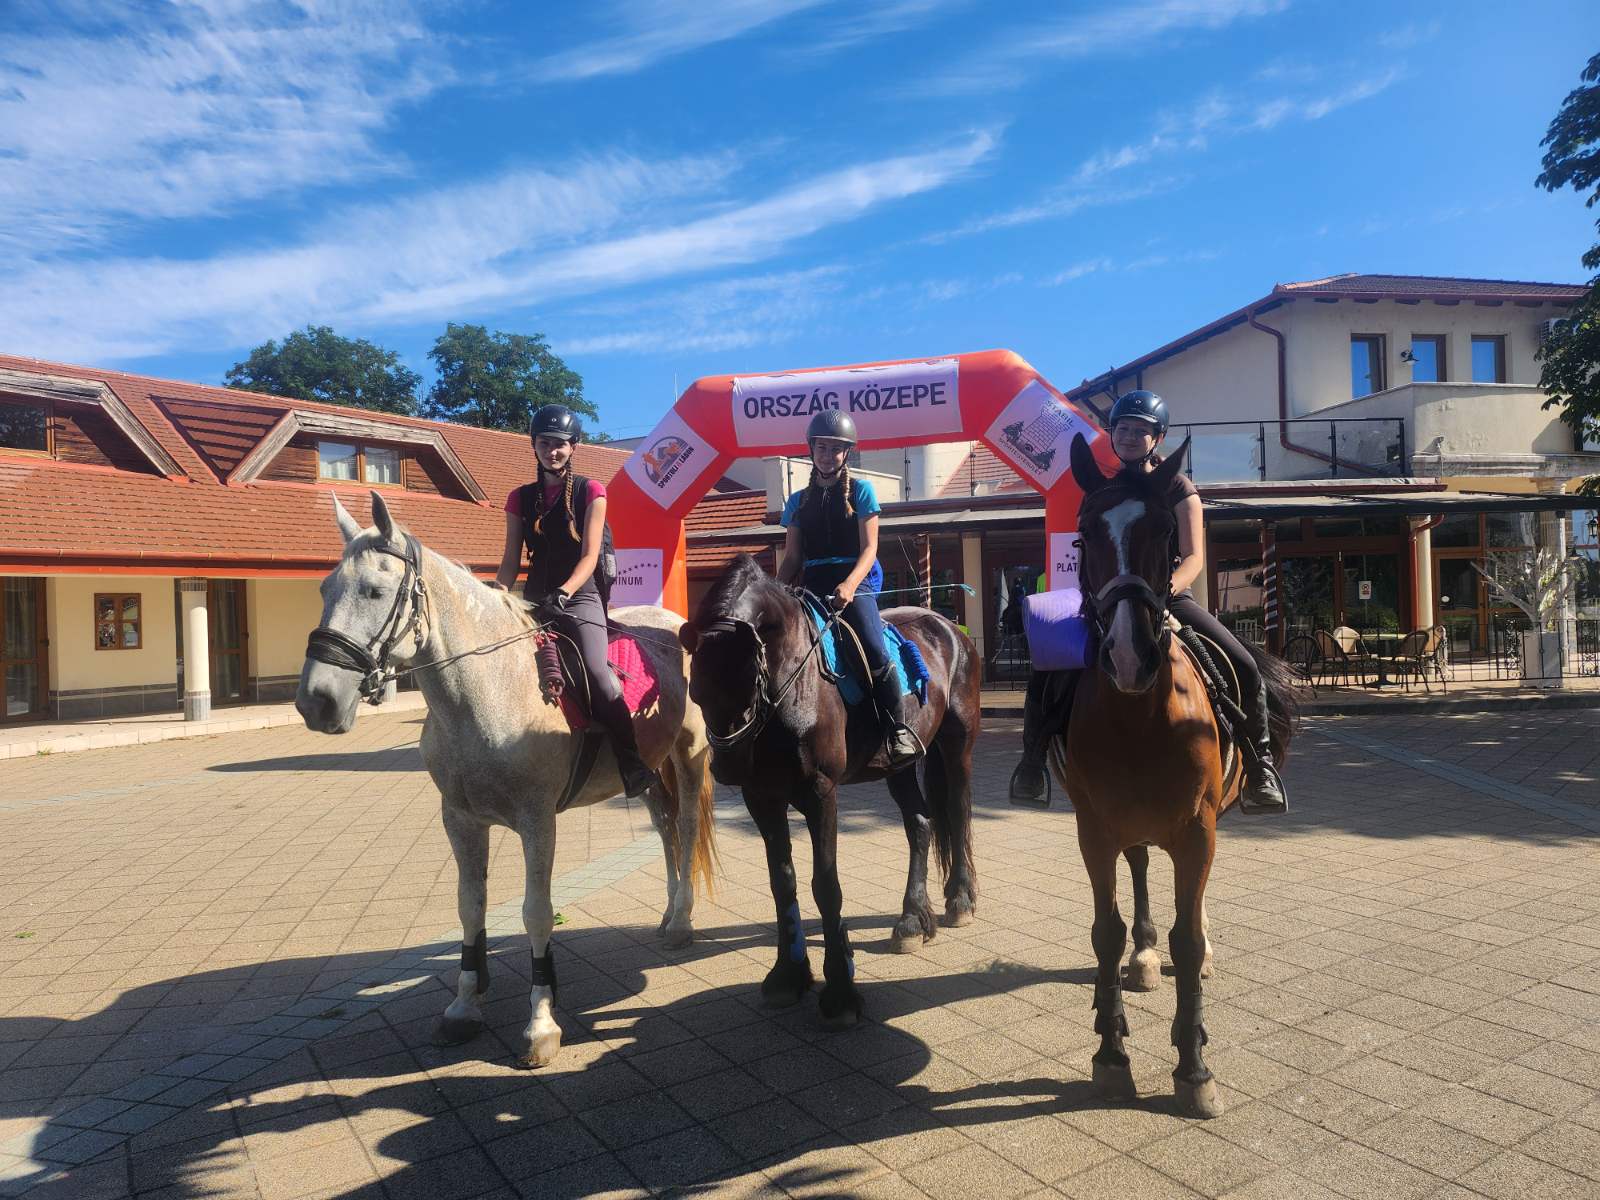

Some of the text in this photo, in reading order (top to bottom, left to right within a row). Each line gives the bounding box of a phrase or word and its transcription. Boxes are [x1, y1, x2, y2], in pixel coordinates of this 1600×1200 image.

[743, 381, 947, 419] ORSZÁG KÖZEPE
[1046, 400, 1074, 428] STABIL
[1056, 562, 1079, 573] PLAT
